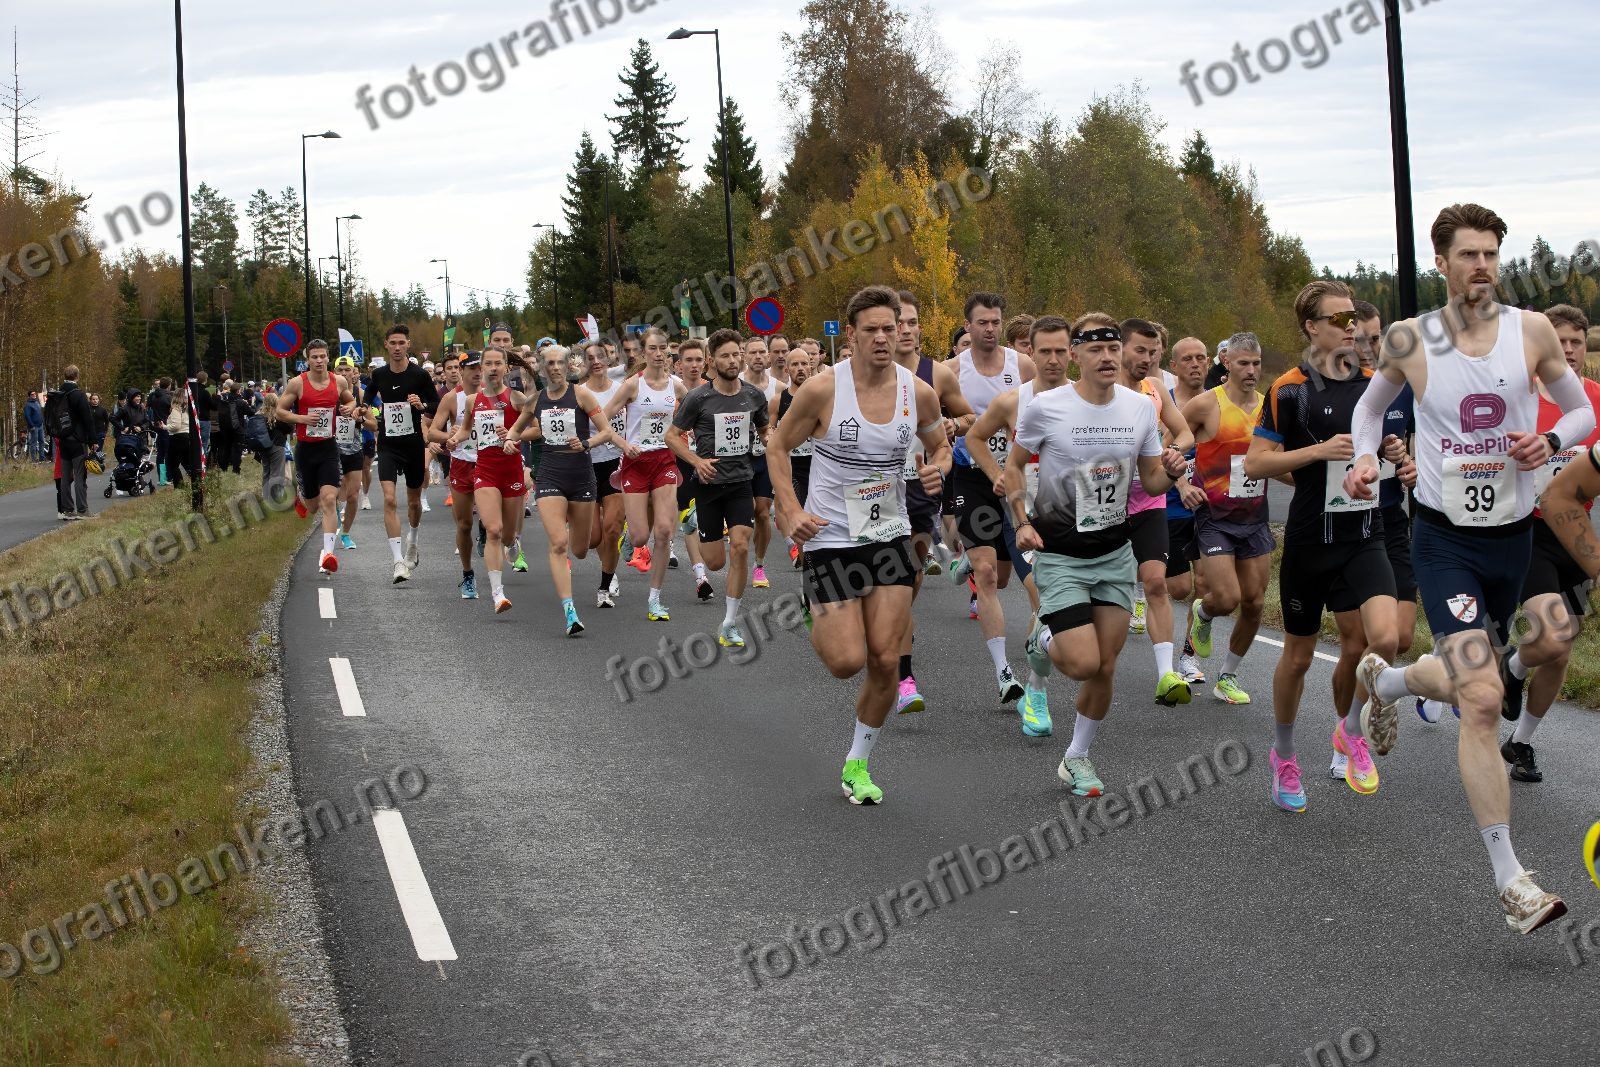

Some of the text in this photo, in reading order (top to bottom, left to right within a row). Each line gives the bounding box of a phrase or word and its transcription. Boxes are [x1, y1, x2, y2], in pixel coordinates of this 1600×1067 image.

[312, 417, 328, 428] 92
[391, 413, 404, 424] 20
[339, 425, 349, 434] 23
[481, 423, 496, 436] 24
[550, 420, 565, 433] 33
[611, 421, 625, 433] 35
[650, 422, 663, 434] 36
[725, 427, 740, 440] 38
[988, 436, 1007, 452] 93
[1089, 464, 1122, 475] NORGES
[1459, 462, 1505, 472] NORGES
[1463, 471, 1498, 480] LØPET
[857, 482, 891, 496] NORGES
[1095, 483, 1116, 505] 12
[861, 490, 887, 501] LØPET
[1465, 485, 1495, 512] 39
[870, 503, 880, 520] 8
